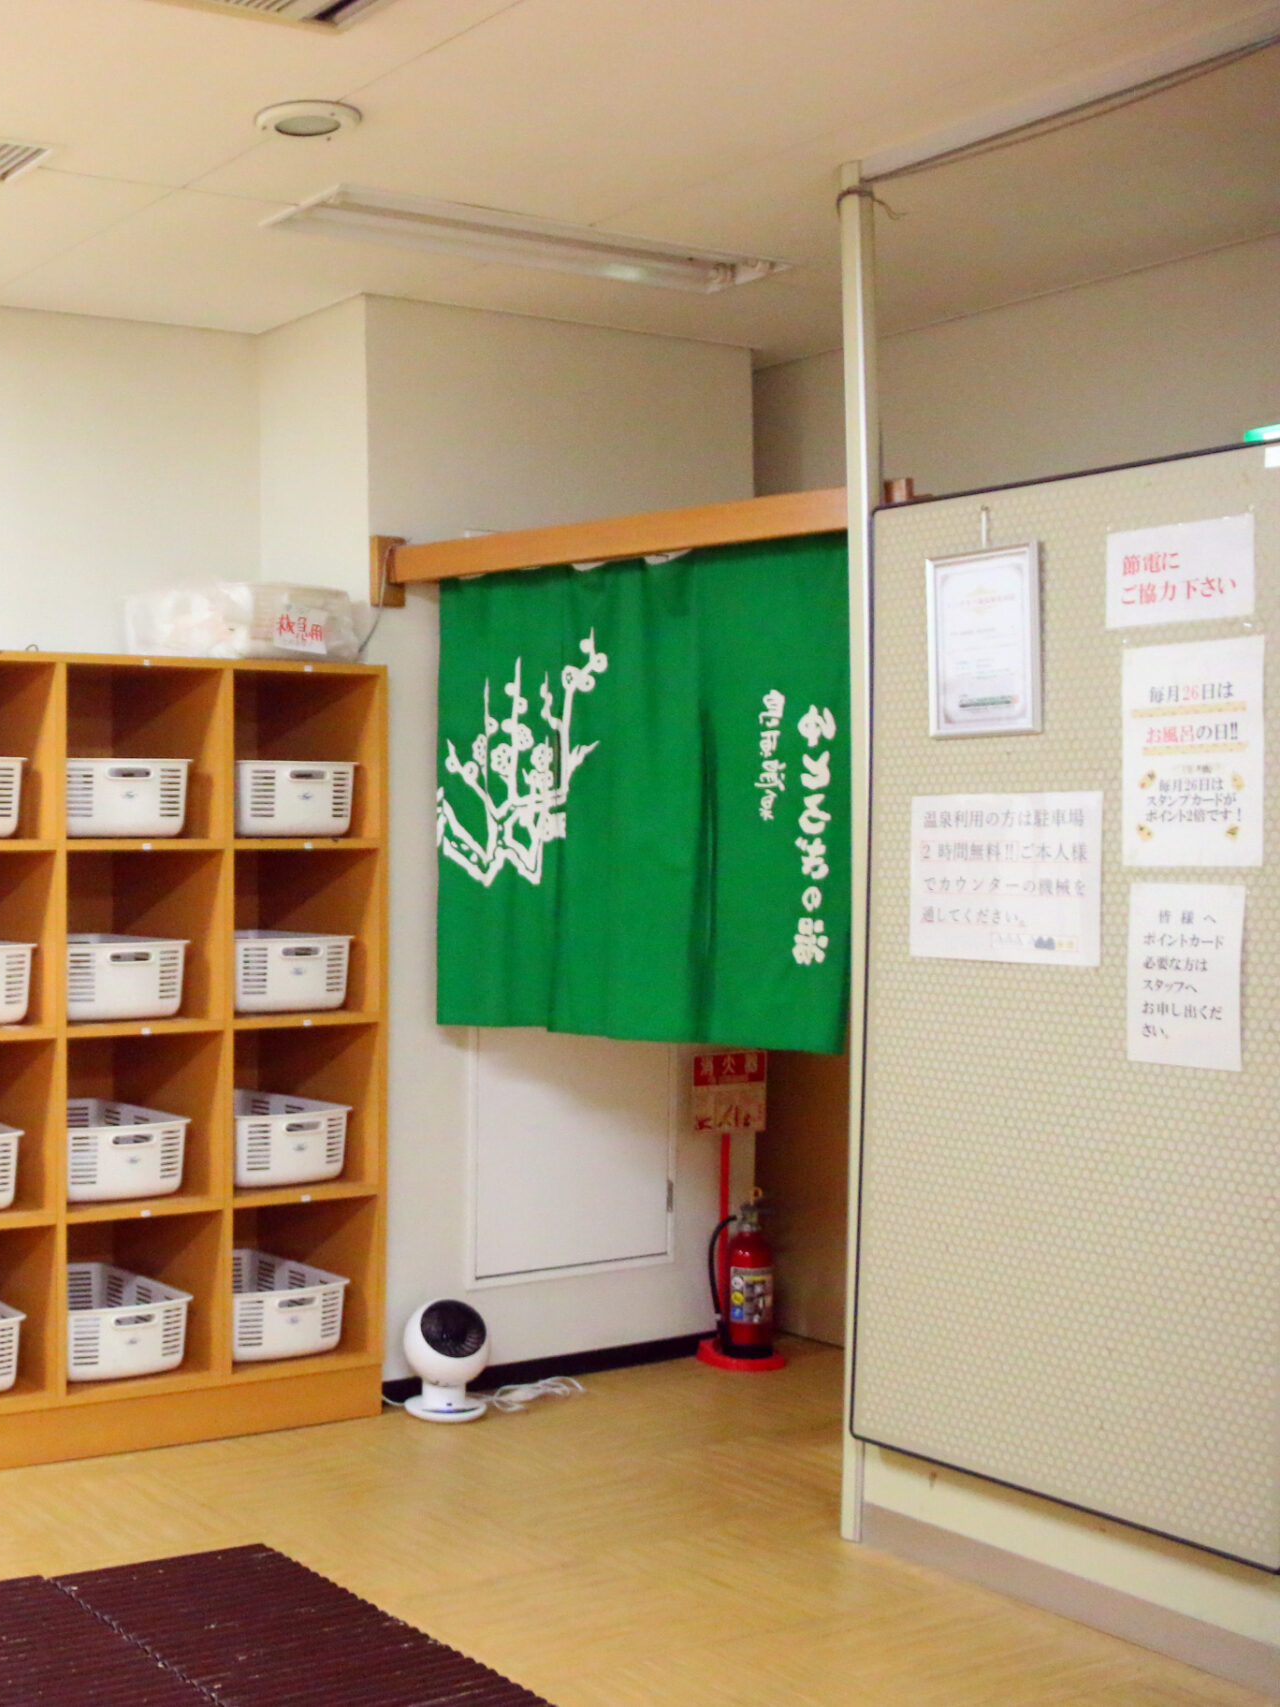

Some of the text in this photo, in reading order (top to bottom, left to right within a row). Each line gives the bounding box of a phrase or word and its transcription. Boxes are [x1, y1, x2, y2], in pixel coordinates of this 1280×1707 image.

[1122, 551, 1181, 577] 節電に
[1120, 576, 1237, 606] ご協力下さい
[1149, 681, 1236, 702] 毎月26日は
[1158, 778, 1225, 793] 毎月26日は
[1147, 792, 1238, 807] スタンプカードが
[923, 809, 1086, 829] 温泉利用の方は駐車場
[923, 876, 1087, 898] でカウンターの機械を
[921, 907, 1028, 926] 通してください。
[1142, 932, 1225, 949] ポイントカード
[1142, 956, 1209, 973] 必要な方は
[1142, 979, 1199, 994] スタッフへ
[1141, 1001, 1224, 1022] お申し出くだ
[1141, 1023, 1170, 1040] さい。
